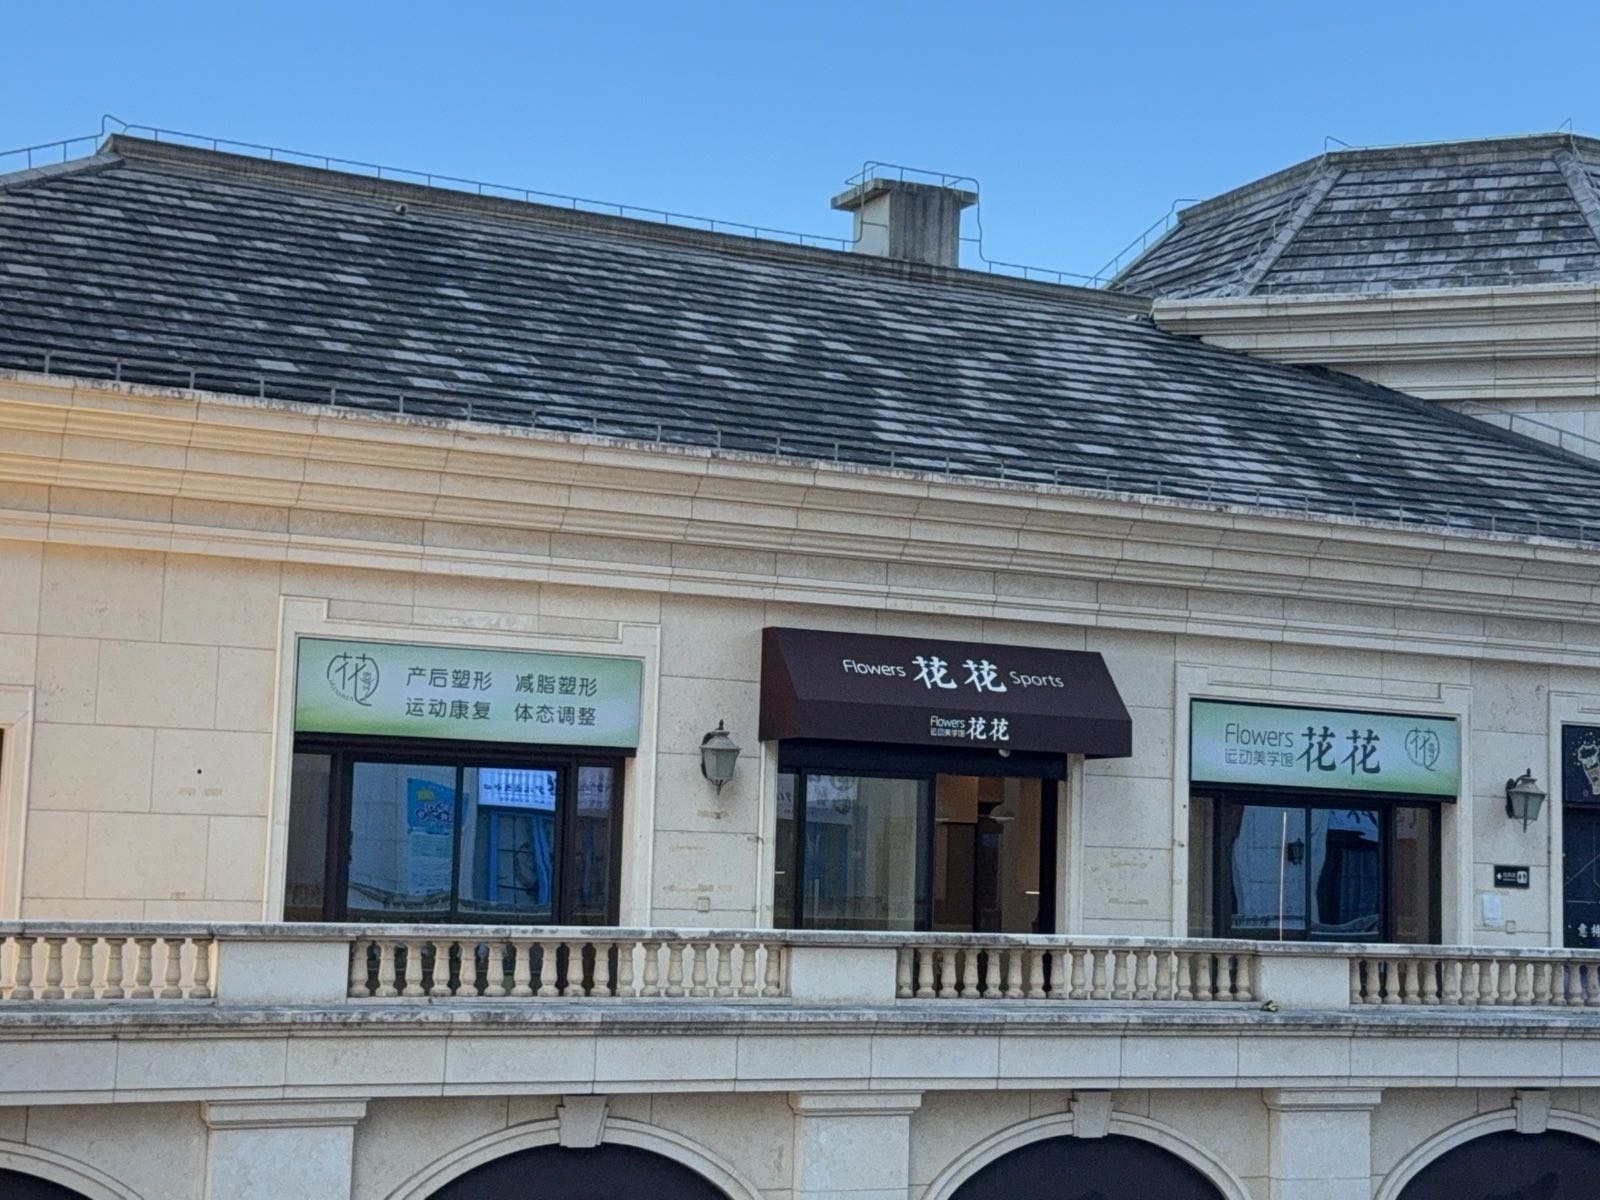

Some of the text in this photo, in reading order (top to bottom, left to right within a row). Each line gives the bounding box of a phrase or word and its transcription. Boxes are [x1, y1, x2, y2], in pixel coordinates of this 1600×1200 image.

[406, 666, 598, 698] 产后塑形 减脂塑形
[842, 656, 1065, 693] Flowers 花花 Sports
[405, 697, 596, 727] 运动康复 体态调整
[930, 715, 966, 729] Flowers
[966, 716, 1010, 741] 花花
[1225, 723, 1294, 748] Flowers
[1225, 748, 1294, 767] 运动美学馆
[1296, 726, 1381, 775] 花花
